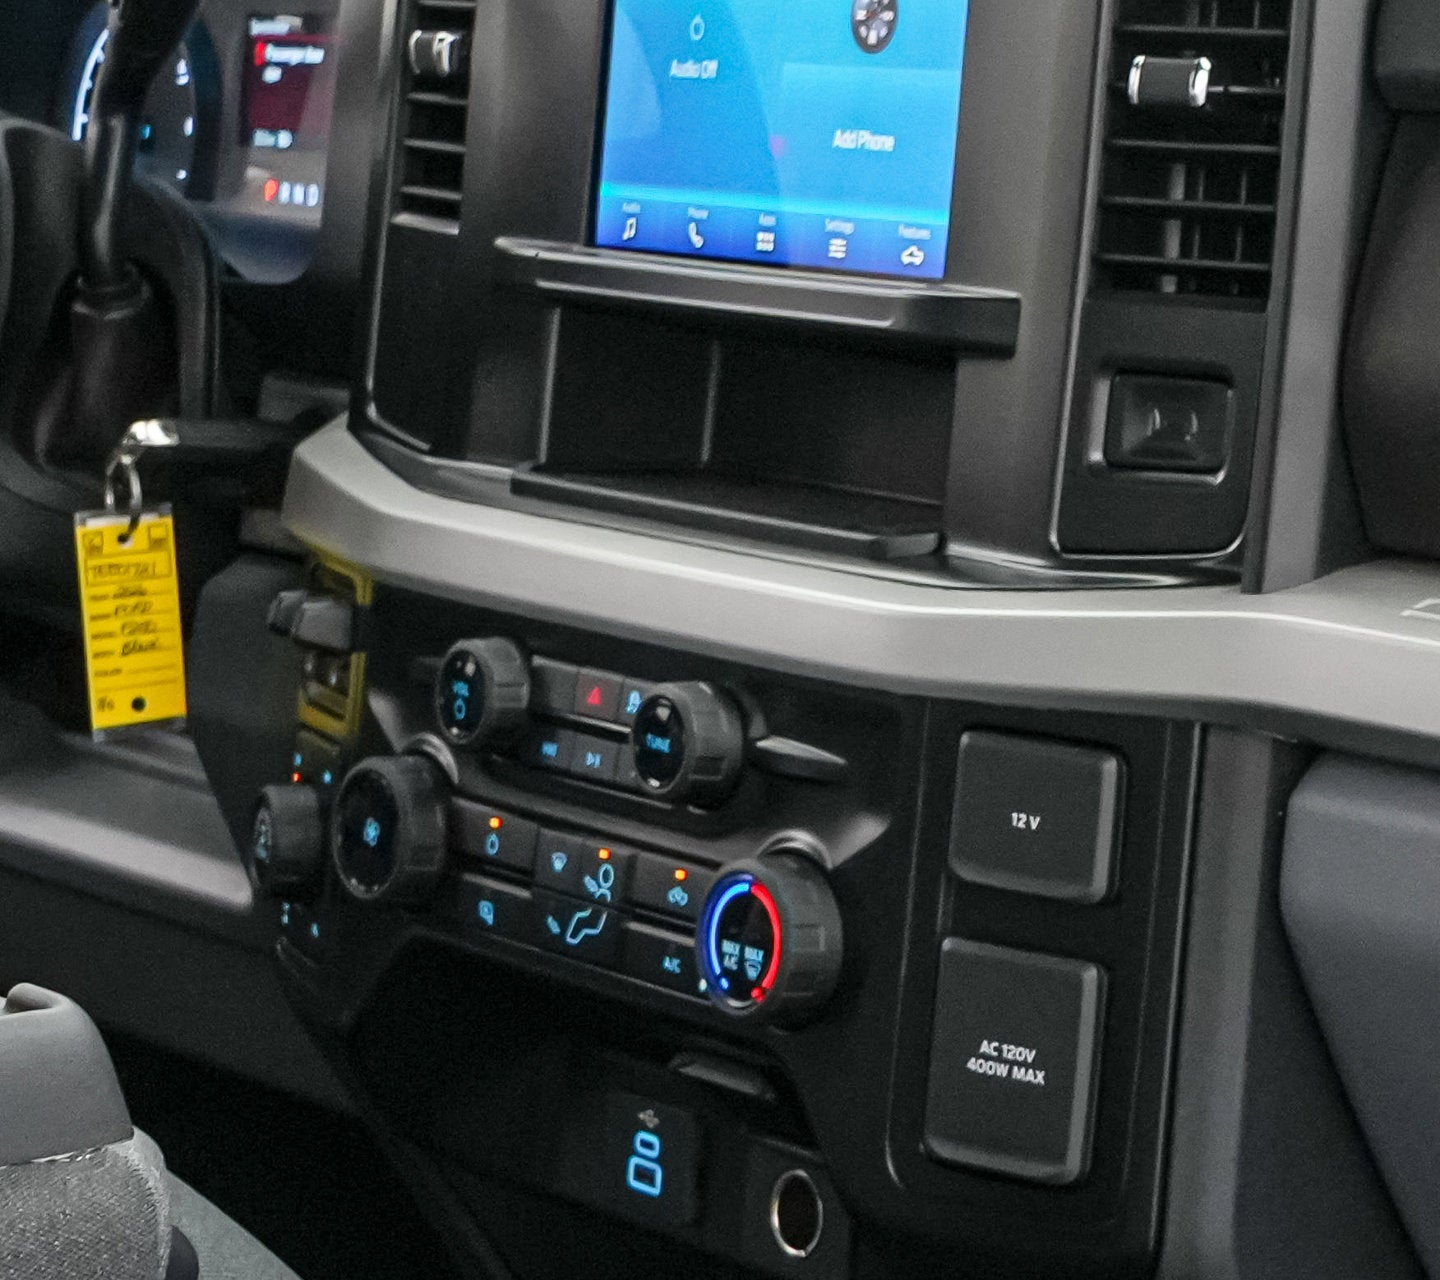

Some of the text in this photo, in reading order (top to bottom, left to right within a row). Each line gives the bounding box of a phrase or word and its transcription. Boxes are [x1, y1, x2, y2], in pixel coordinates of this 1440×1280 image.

[1011, 812, 1041, 830] 12 V
[979, 1039, 1036, 1064] AC 120V
[966, 1057, 1045, 1086] 400W MAX
